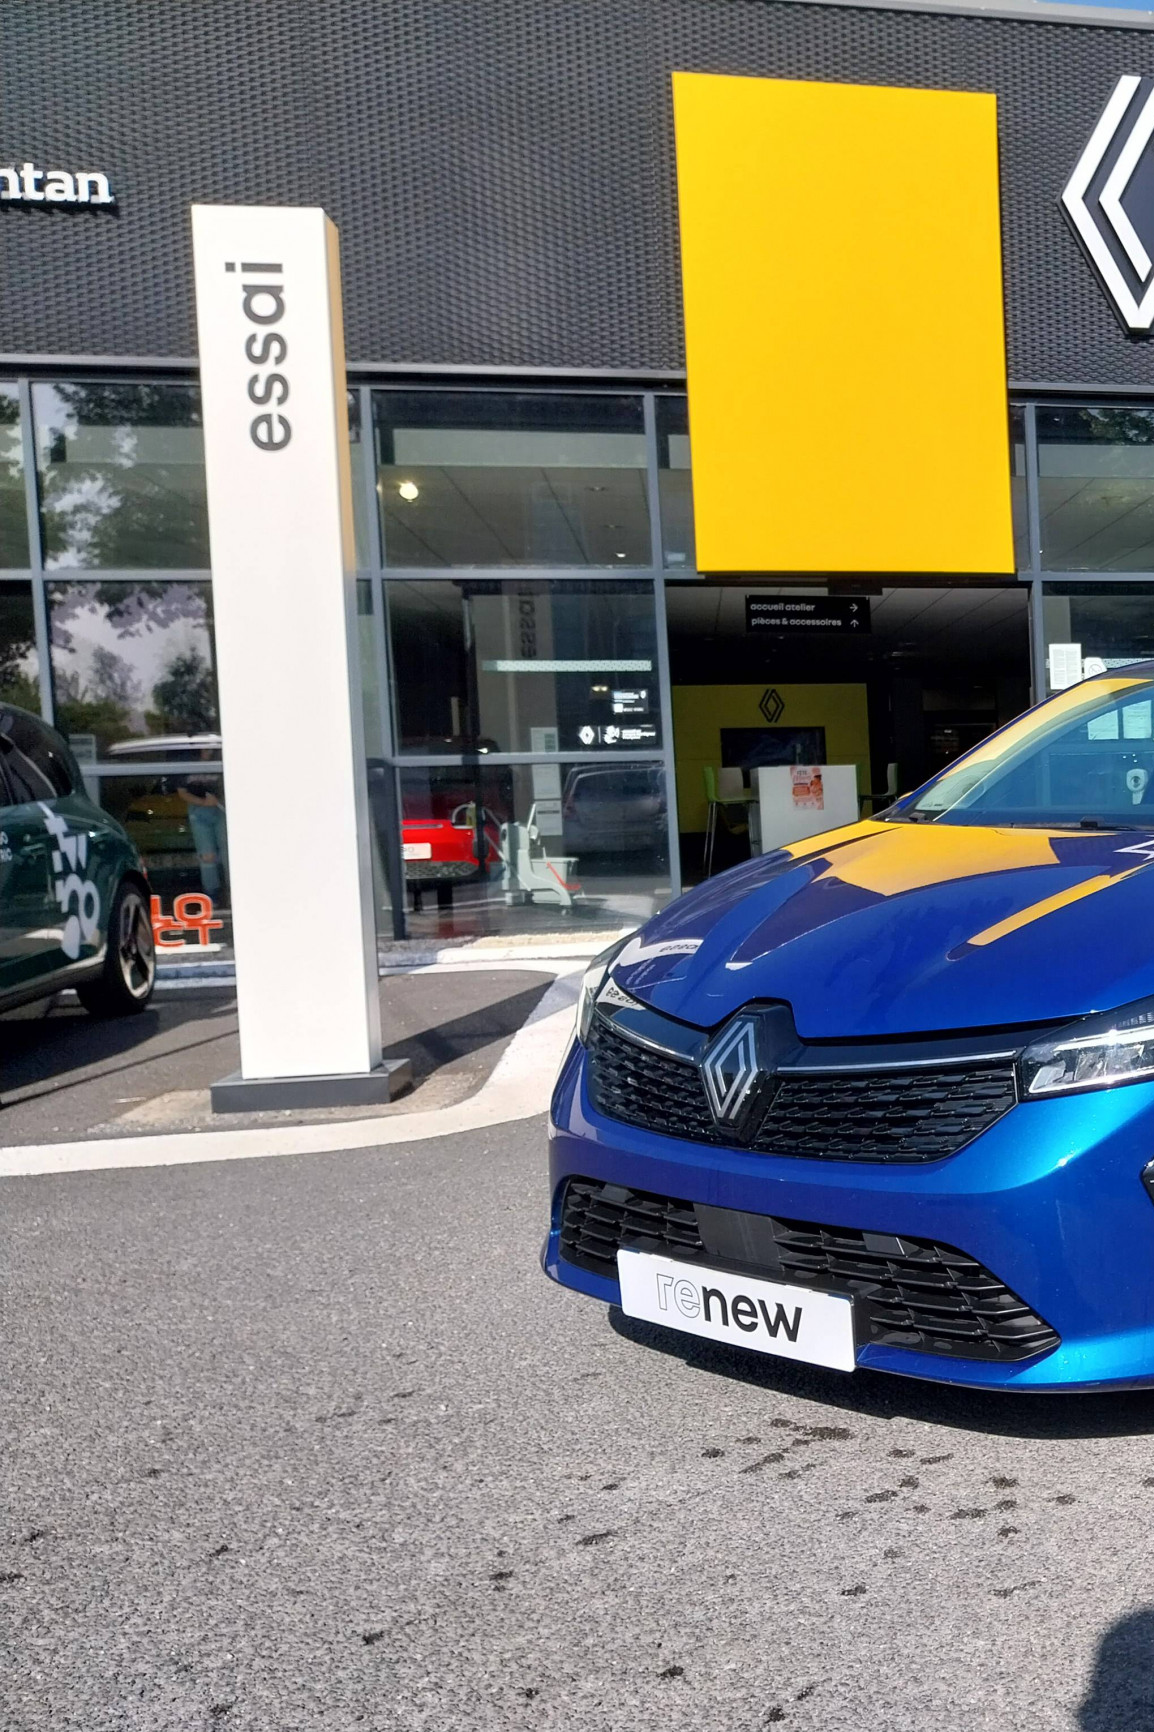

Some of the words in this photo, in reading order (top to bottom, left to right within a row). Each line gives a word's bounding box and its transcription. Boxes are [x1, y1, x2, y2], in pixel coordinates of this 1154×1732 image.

[0, 162, 115, 203] ntan
[225, 262, 292, 452] essai
[750, 602, 784, 611] accueil
[785, 603, 815, 612] atelier
[751, 616, 781, 626] pièces
[789, 618, 842, 626] accessoires
[656, 1272, 803, 1343] renew
